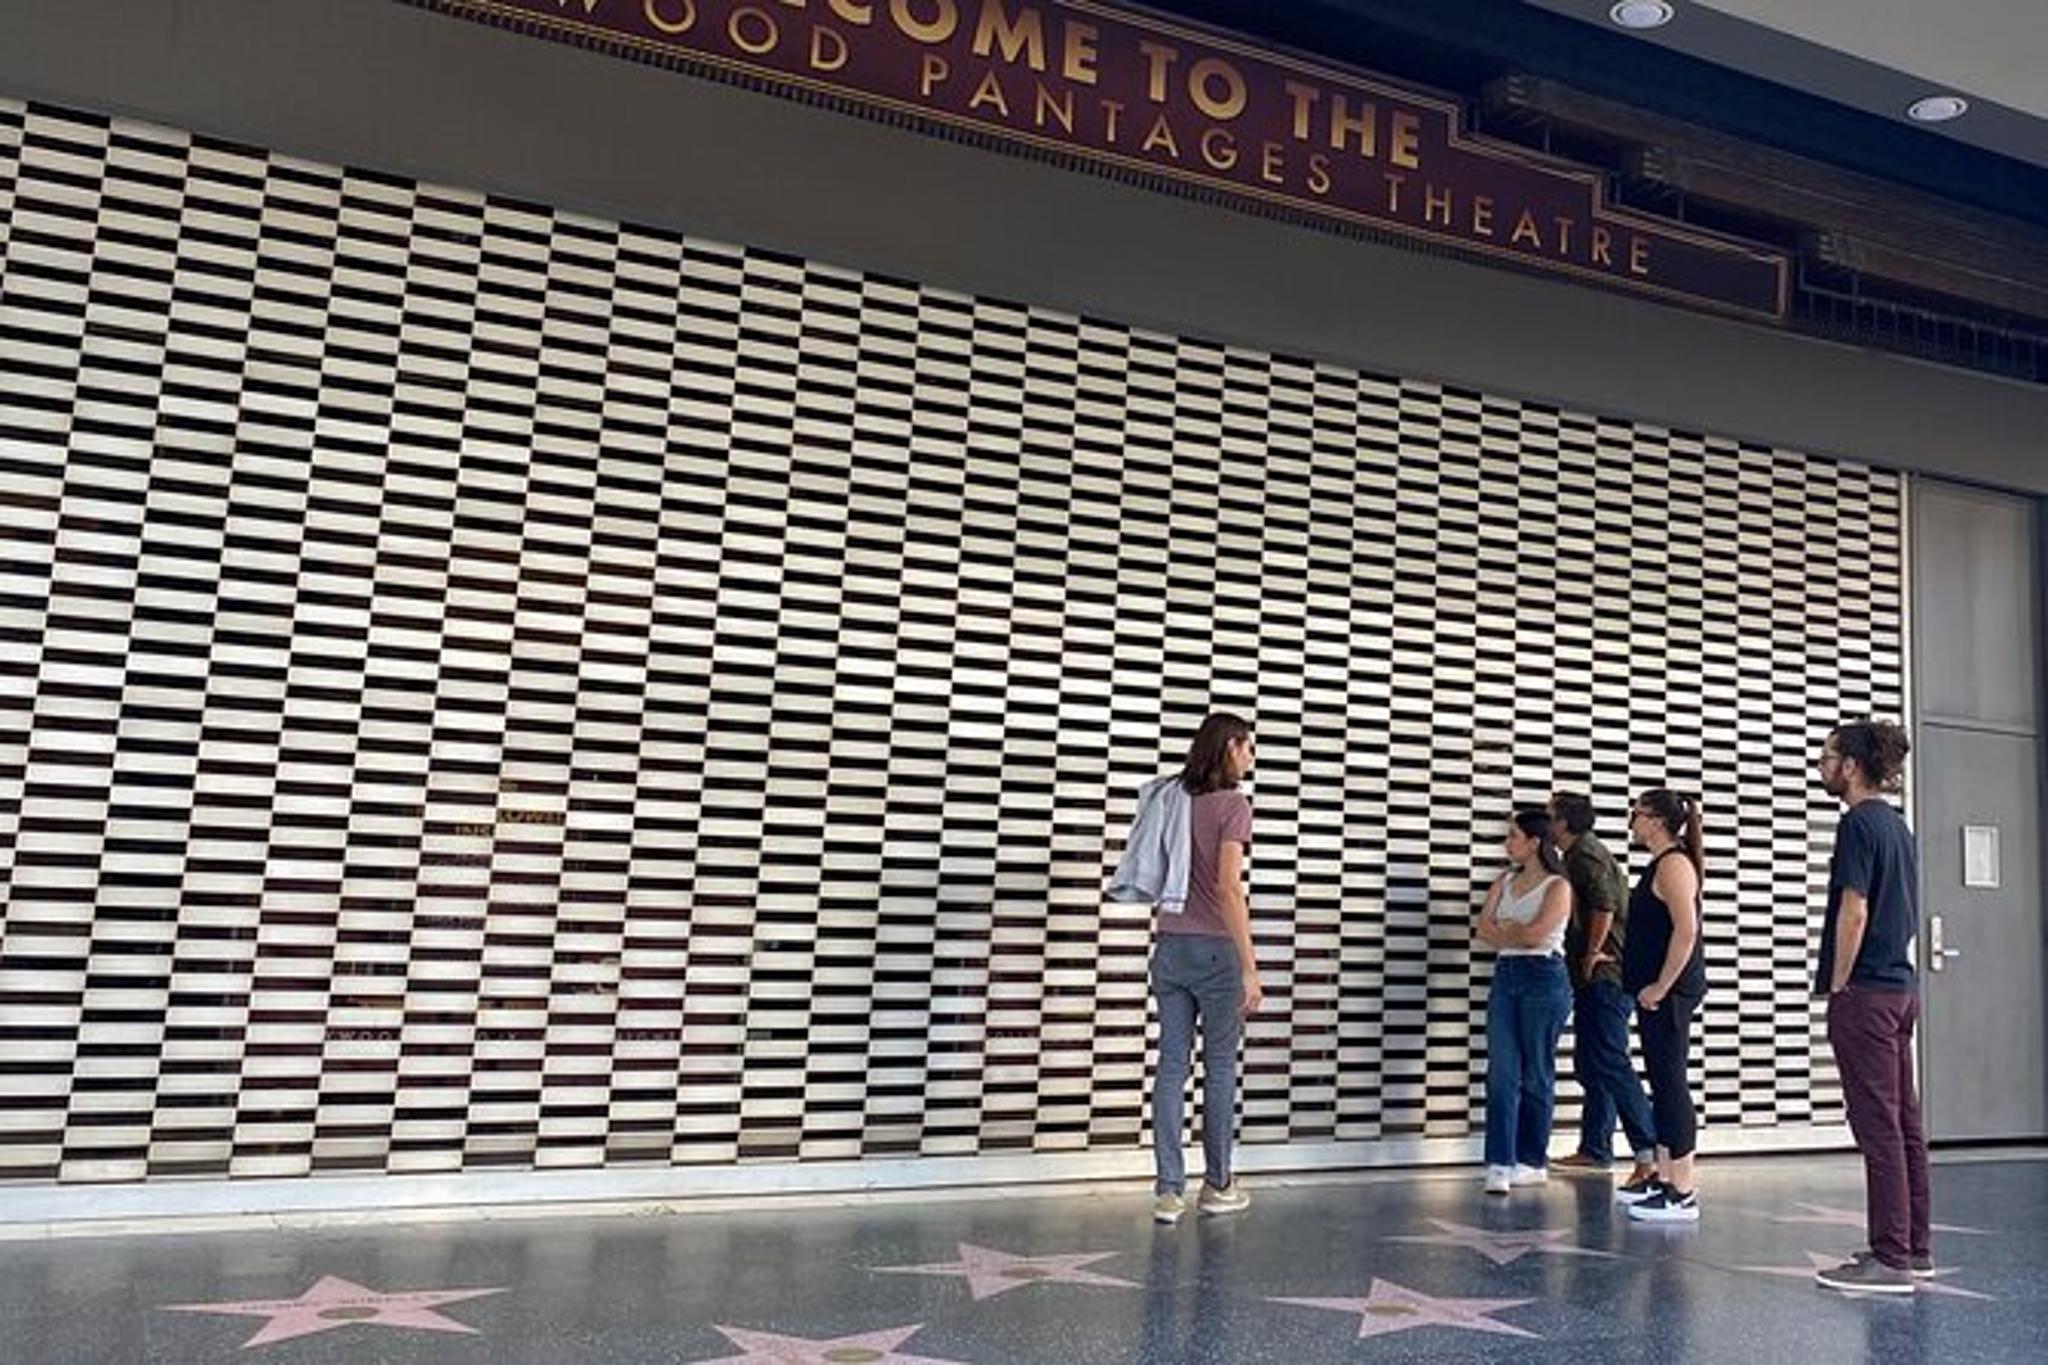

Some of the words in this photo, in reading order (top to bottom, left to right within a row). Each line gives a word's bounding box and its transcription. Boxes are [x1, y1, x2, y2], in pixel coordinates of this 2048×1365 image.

[557, 0, 847, 70] OOD
[921, 53, 1330, 194] PANTAGES
[1384, 173, 1649, 275] THEATRE
[778, 0, 1097, 84] OME
[1141, 39, 1247, 120] TO
[1285, 81, 1420, 170] THE
